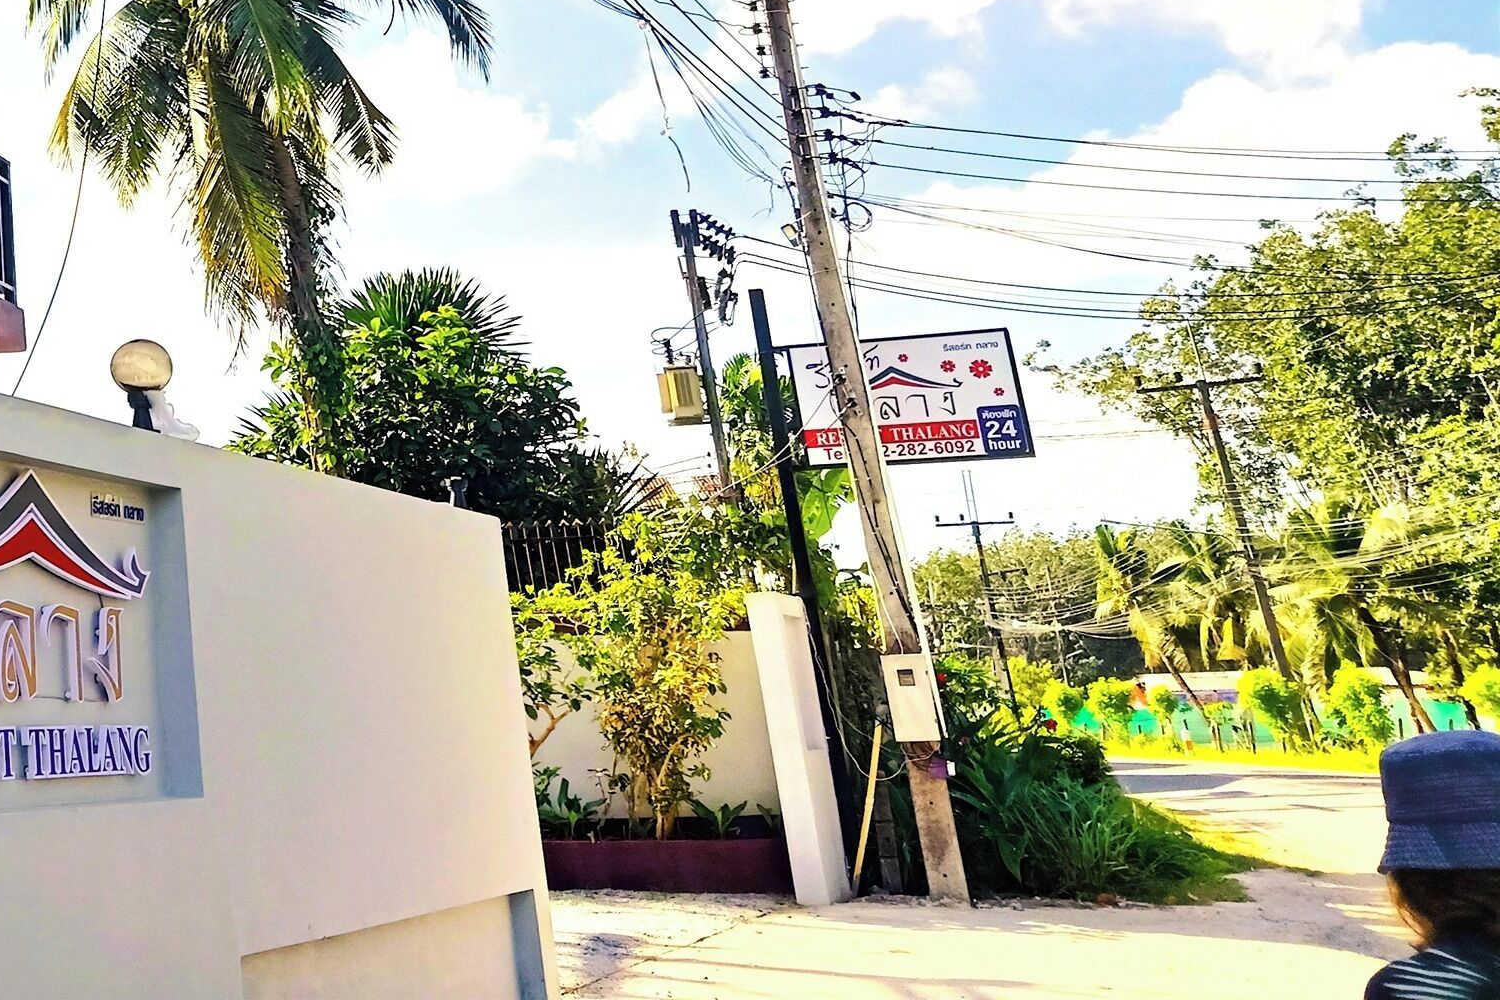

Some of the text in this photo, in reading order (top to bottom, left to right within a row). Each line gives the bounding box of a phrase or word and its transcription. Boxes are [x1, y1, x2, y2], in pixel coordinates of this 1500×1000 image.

[873, 390, 956, 420] ลาง
[889, 422, 975, 441] THALANG
[984, 419, 1018, 439] 24
[988, 439, 1022, 450] hour
[28, 725, 152, 779] THALANG
